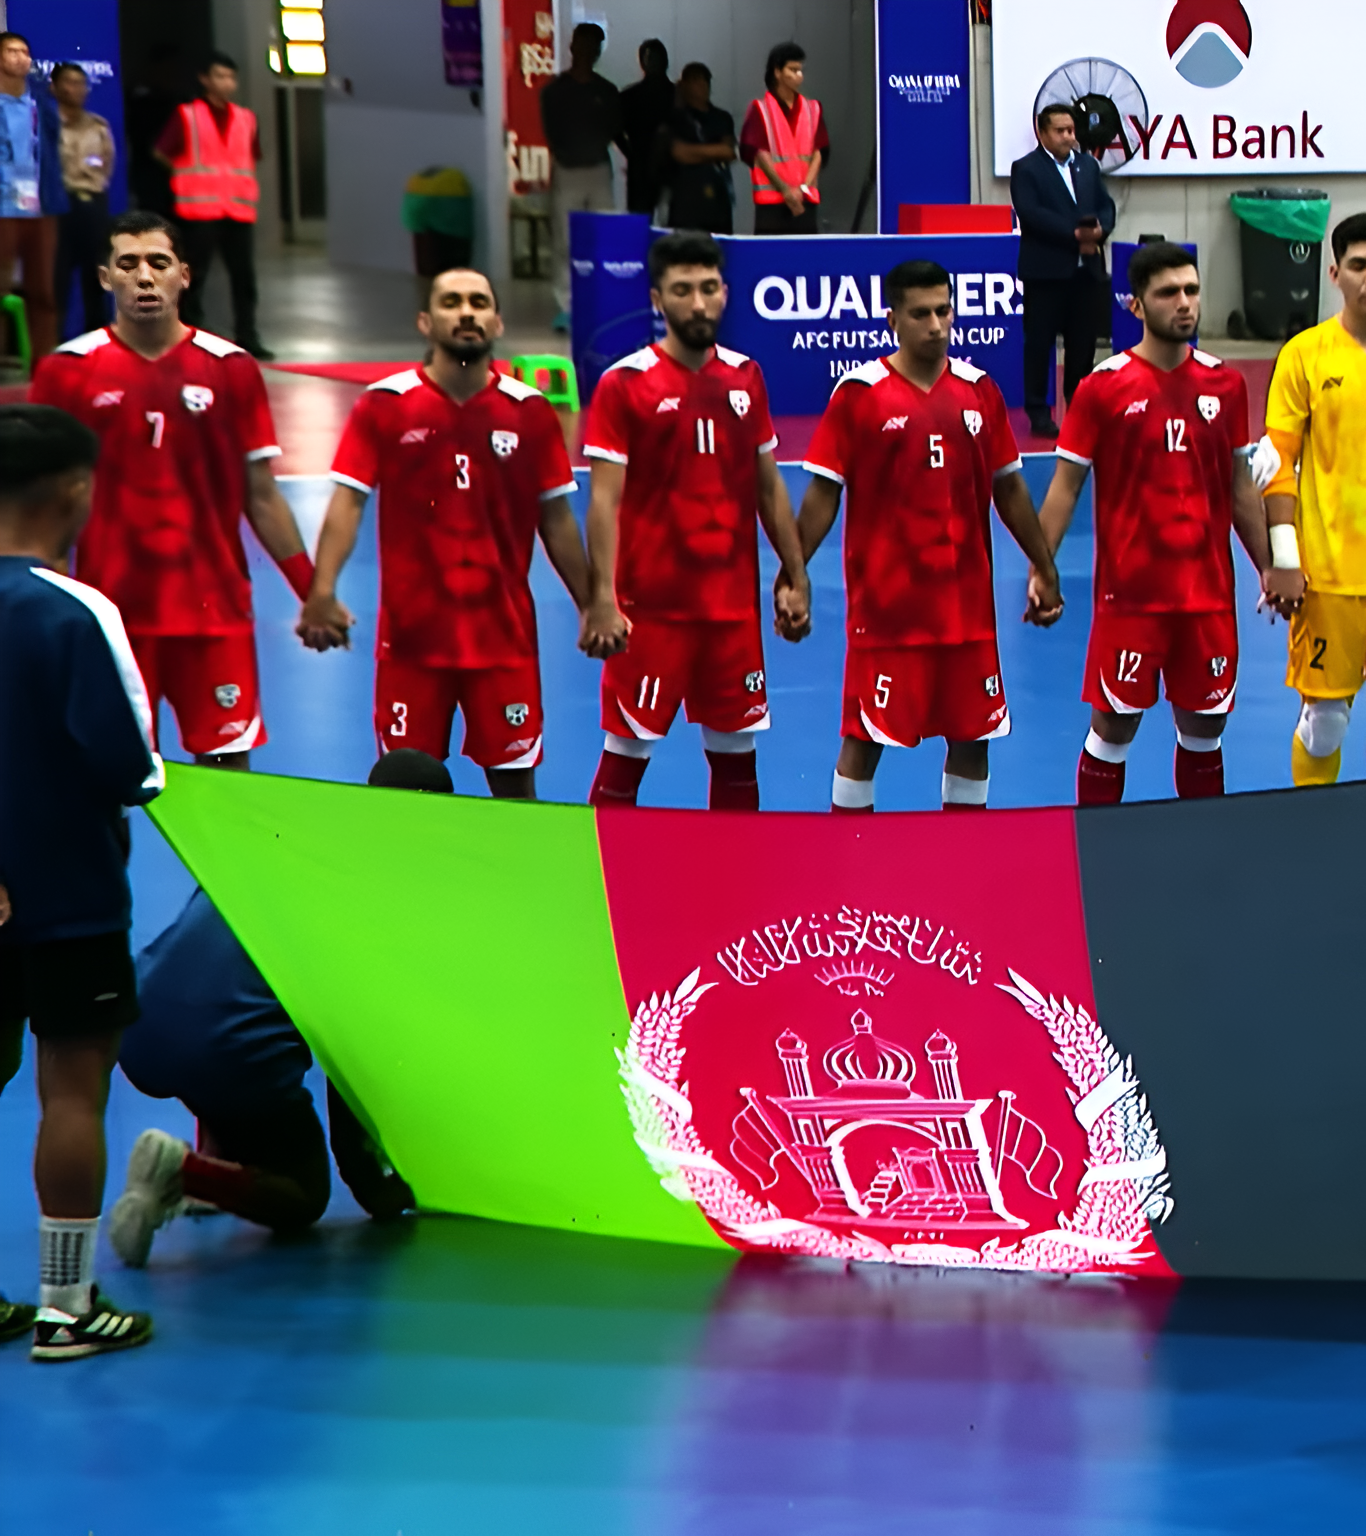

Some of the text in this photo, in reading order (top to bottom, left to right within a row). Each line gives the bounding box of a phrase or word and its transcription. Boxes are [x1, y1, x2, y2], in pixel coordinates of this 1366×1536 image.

[1212, 110, 1326, 159] Bank
[792, 331, 829, 350] AFC
[832, 329, 900, 349] FUTSAL
[967, 326, 1006, 345] CUP
[146, 411, 165, 447] 7
[697, 418, 715, 454] 11
[1165, 419, 1188, 453] 12
[928, 434, 944, 469] 5
[455, 454, 470, 490] 3
[1116, 649, 1143, 682] 12
[1309, 638, 1328, 670] 2
[637, 675, 661, 711] 11
[875, 673, 893, 709] 5
[391, 702, 409, 737] 3
